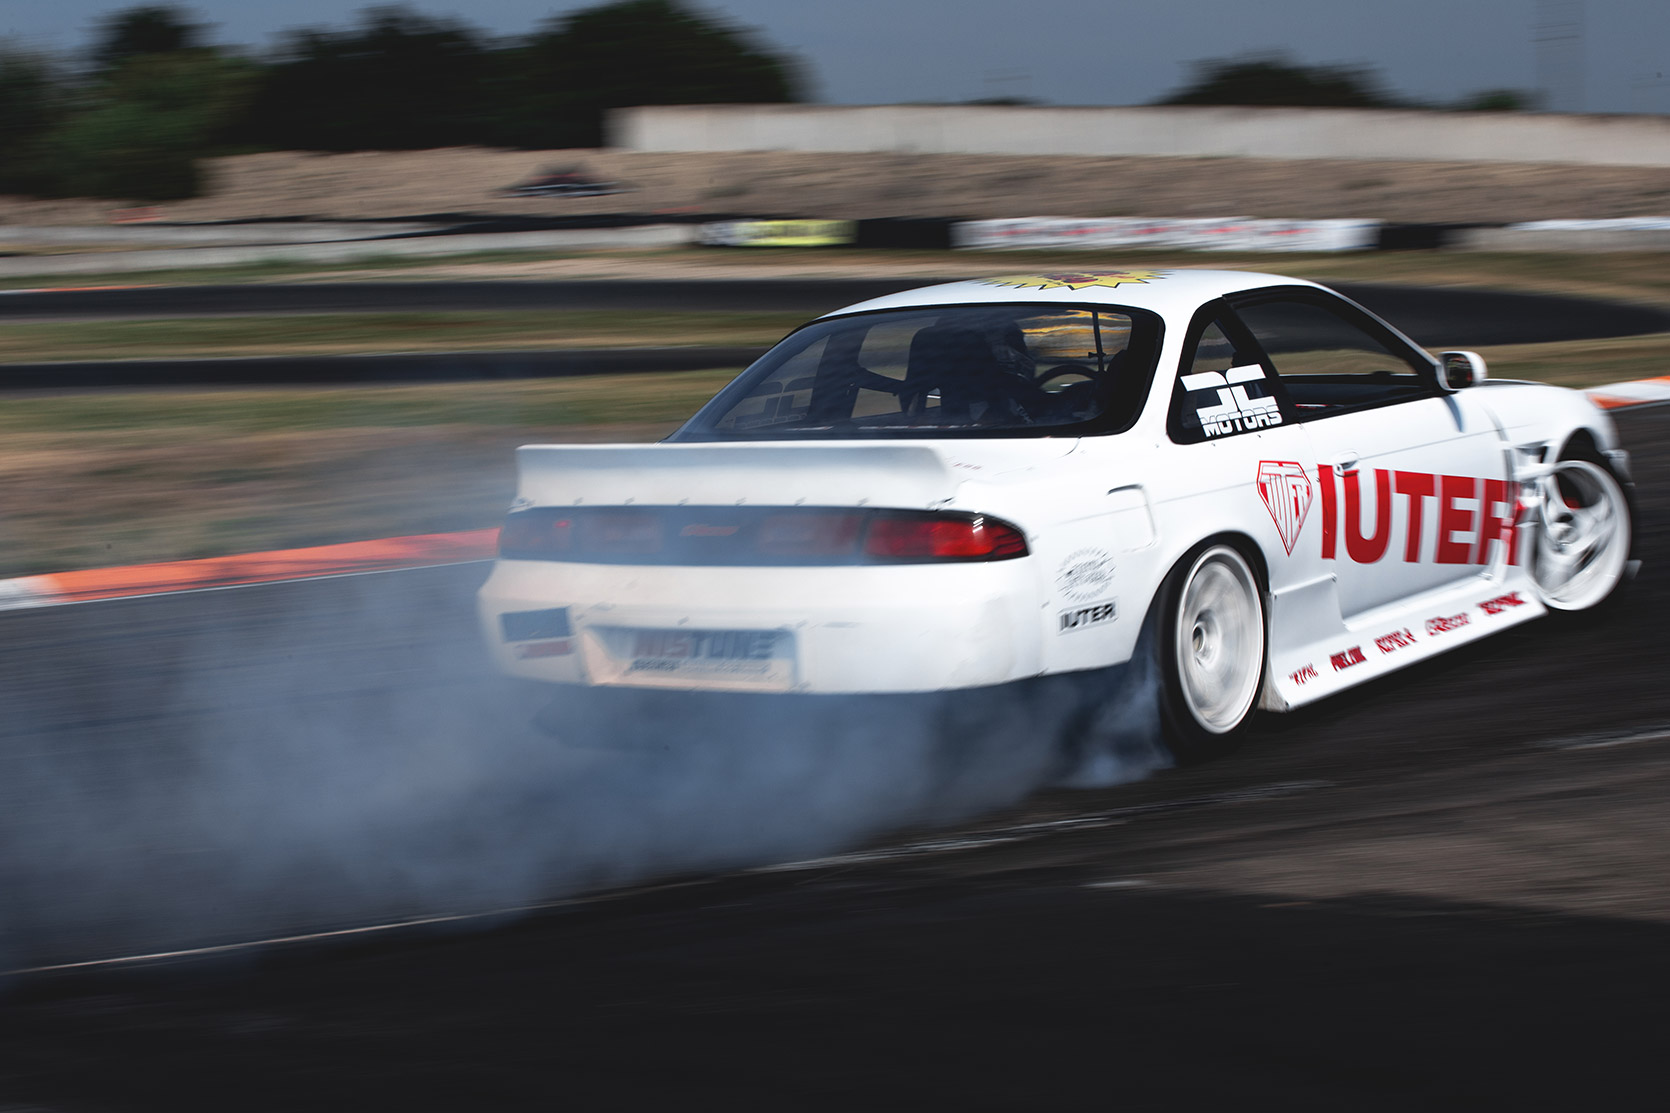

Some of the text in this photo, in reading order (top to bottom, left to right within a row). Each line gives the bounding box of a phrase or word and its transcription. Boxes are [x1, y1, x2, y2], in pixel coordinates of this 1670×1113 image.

[1200, 403, 1283, 438] MOTORS
[1317, 464, 1520, 567] IUTER
[1060, 601, 1116, 631] IUTER
